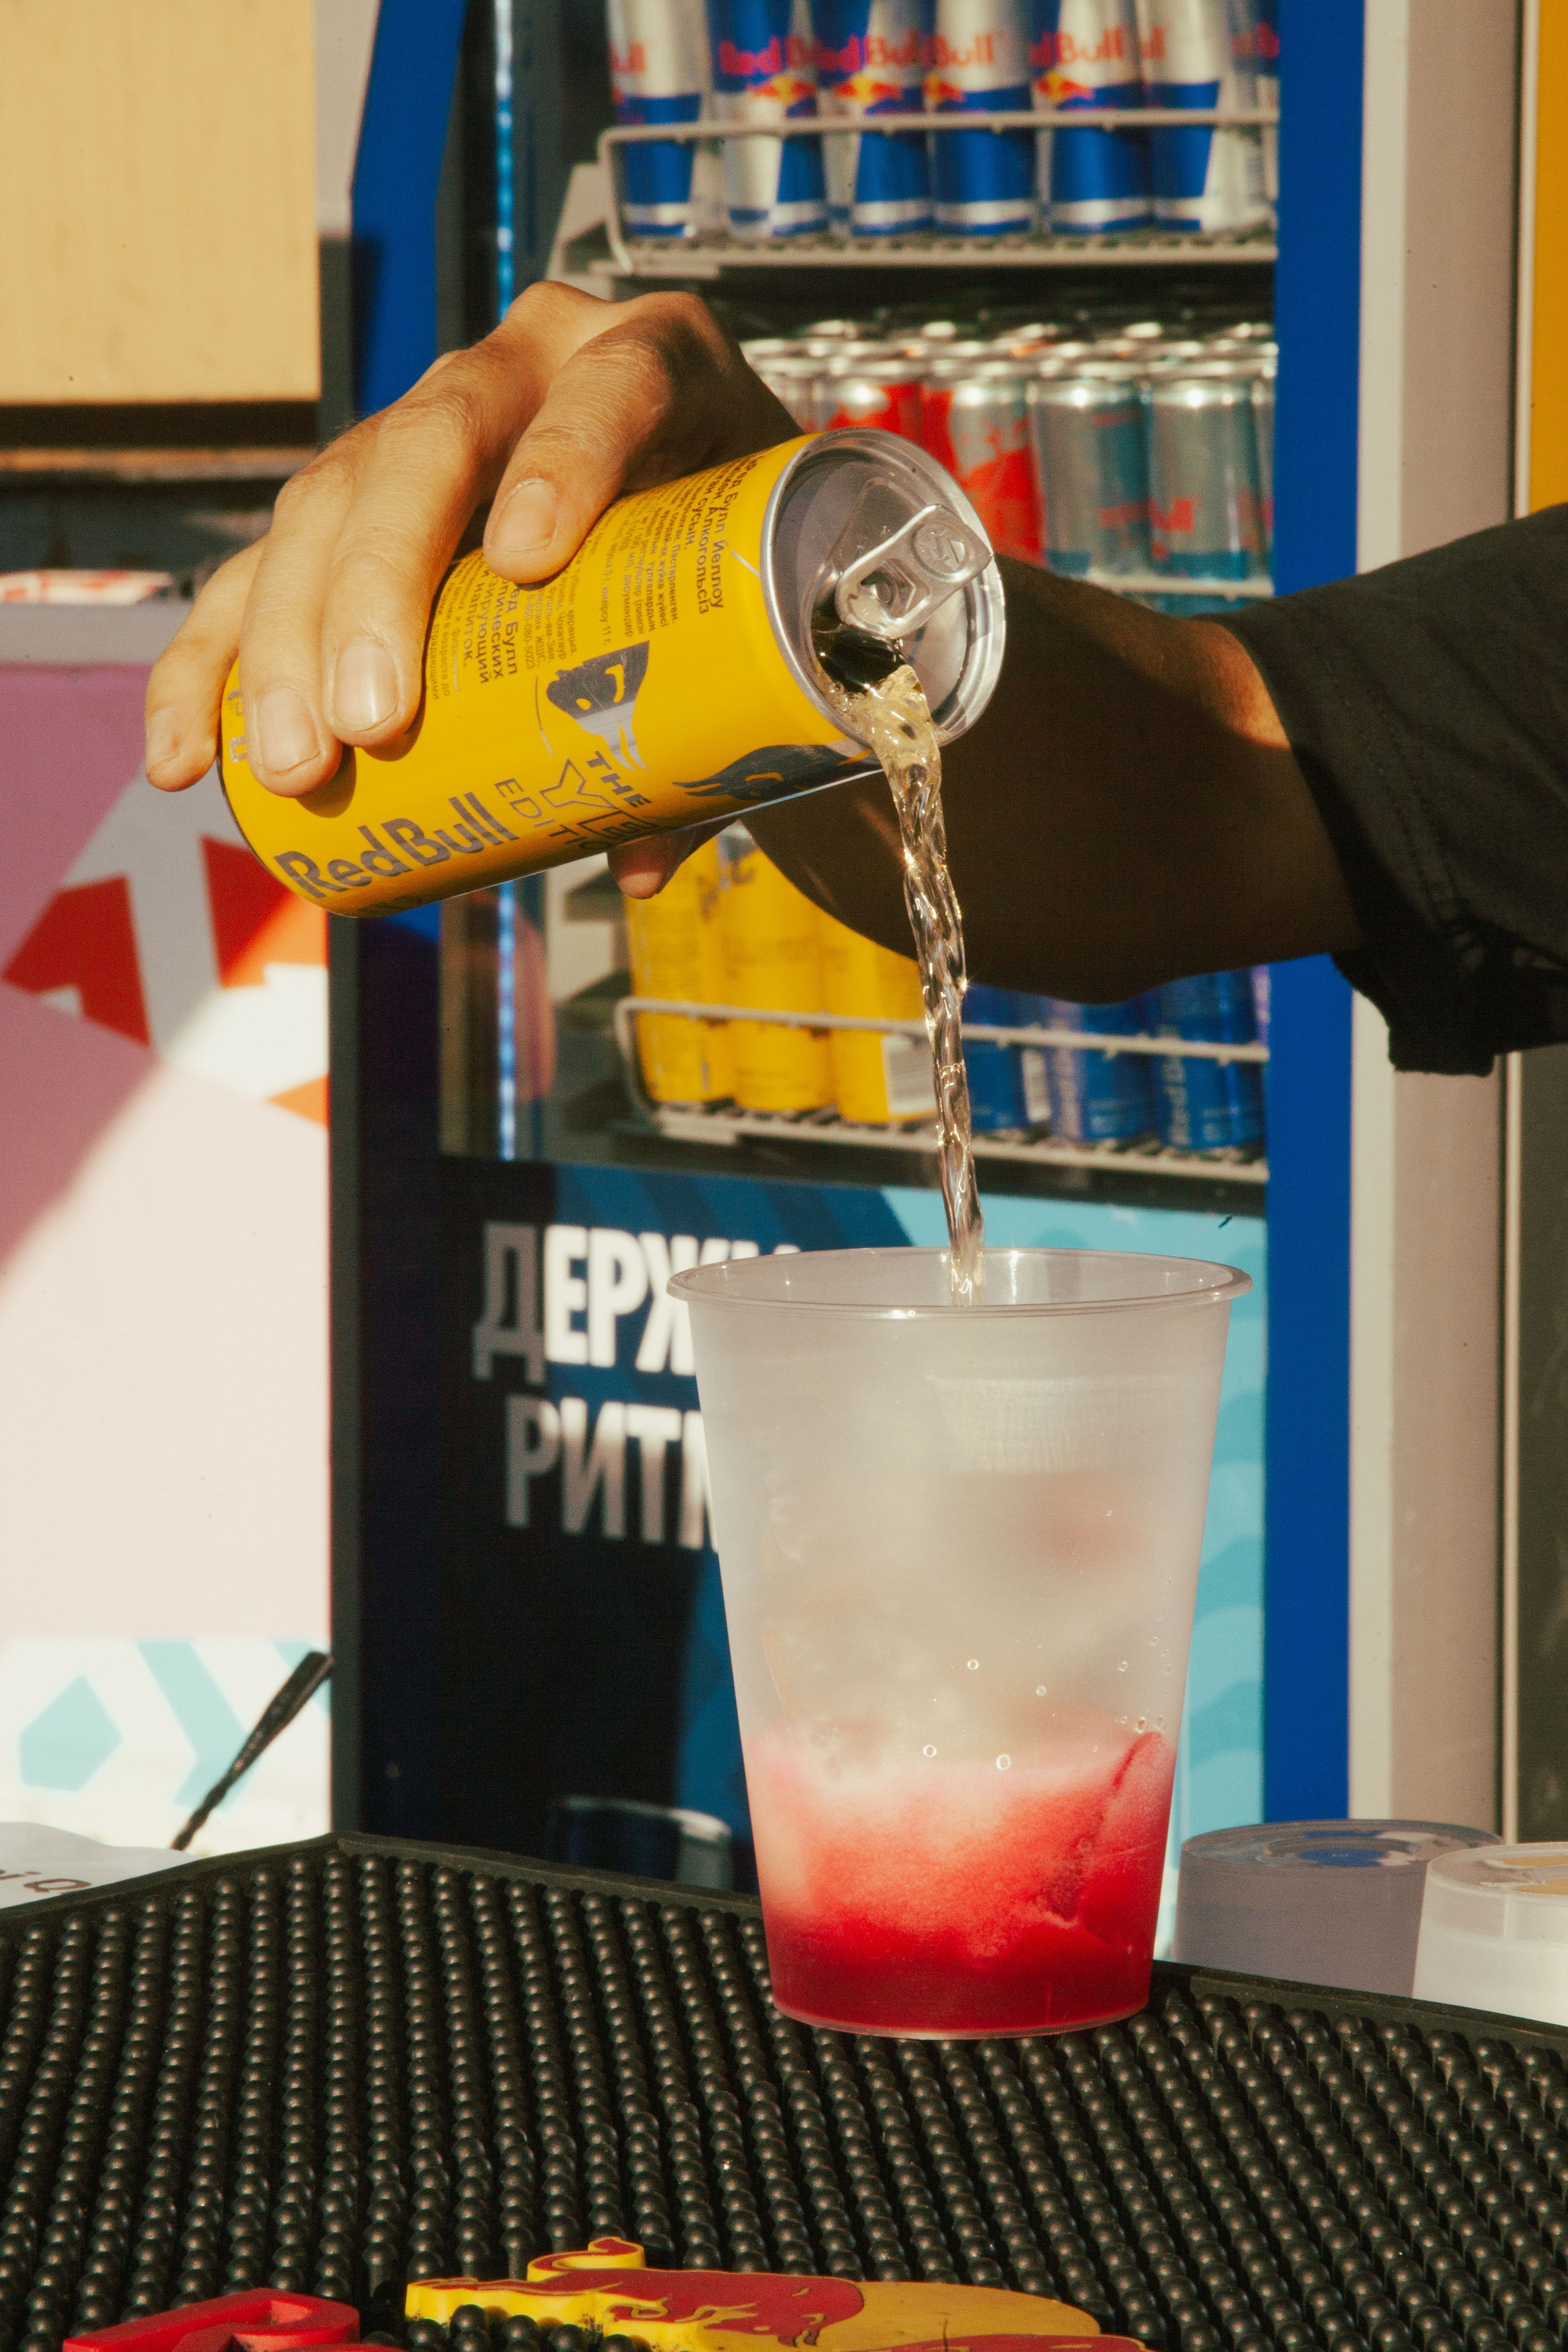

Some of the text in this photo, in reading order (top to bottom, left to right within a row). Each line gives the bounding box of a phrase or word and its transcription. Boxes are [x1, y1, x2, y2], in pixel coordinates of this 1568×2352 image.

[695, 503, 721, 614] Алкогольсіз
[710, 537, 729, 611] Йеллоу
[462, 581, 486, 668] напиток.
[502, 619, 518, 676] Булл
[494, 778, 612, 851] EDITIO
[586, 750, 652, 807] THE
[471, 1221, 760, 1385] ДЕРЖ
